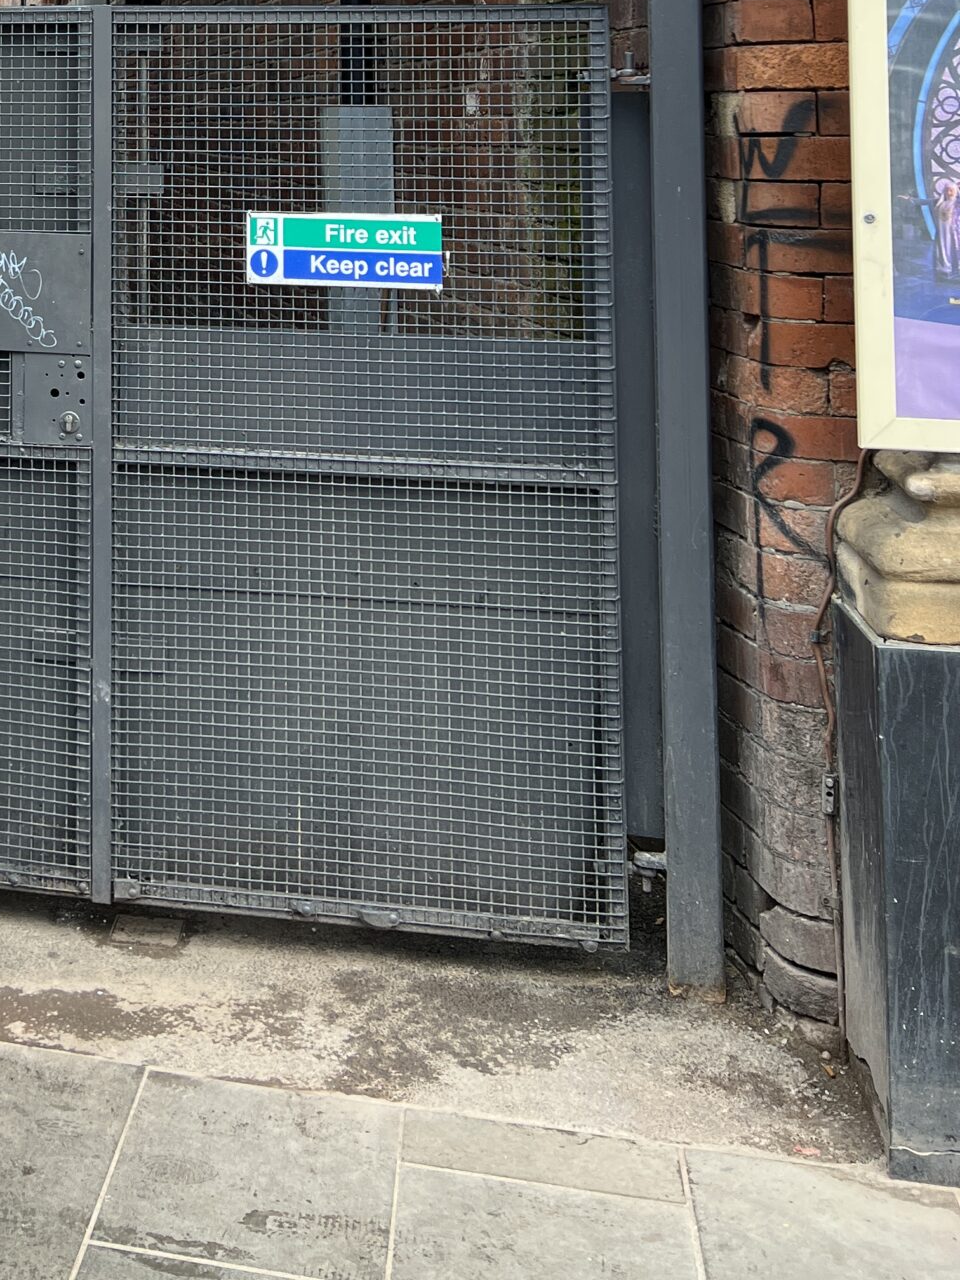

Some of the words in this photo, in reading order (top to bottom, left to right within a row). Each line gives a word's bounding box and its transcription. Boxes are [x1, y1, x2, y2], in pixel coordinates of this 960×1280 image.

[324, 223, 369, 244] Fire
[375, 225, 417, 245] exit
[310, 255, 369, 279] Keep
[375, 257, 433, 277] clear
